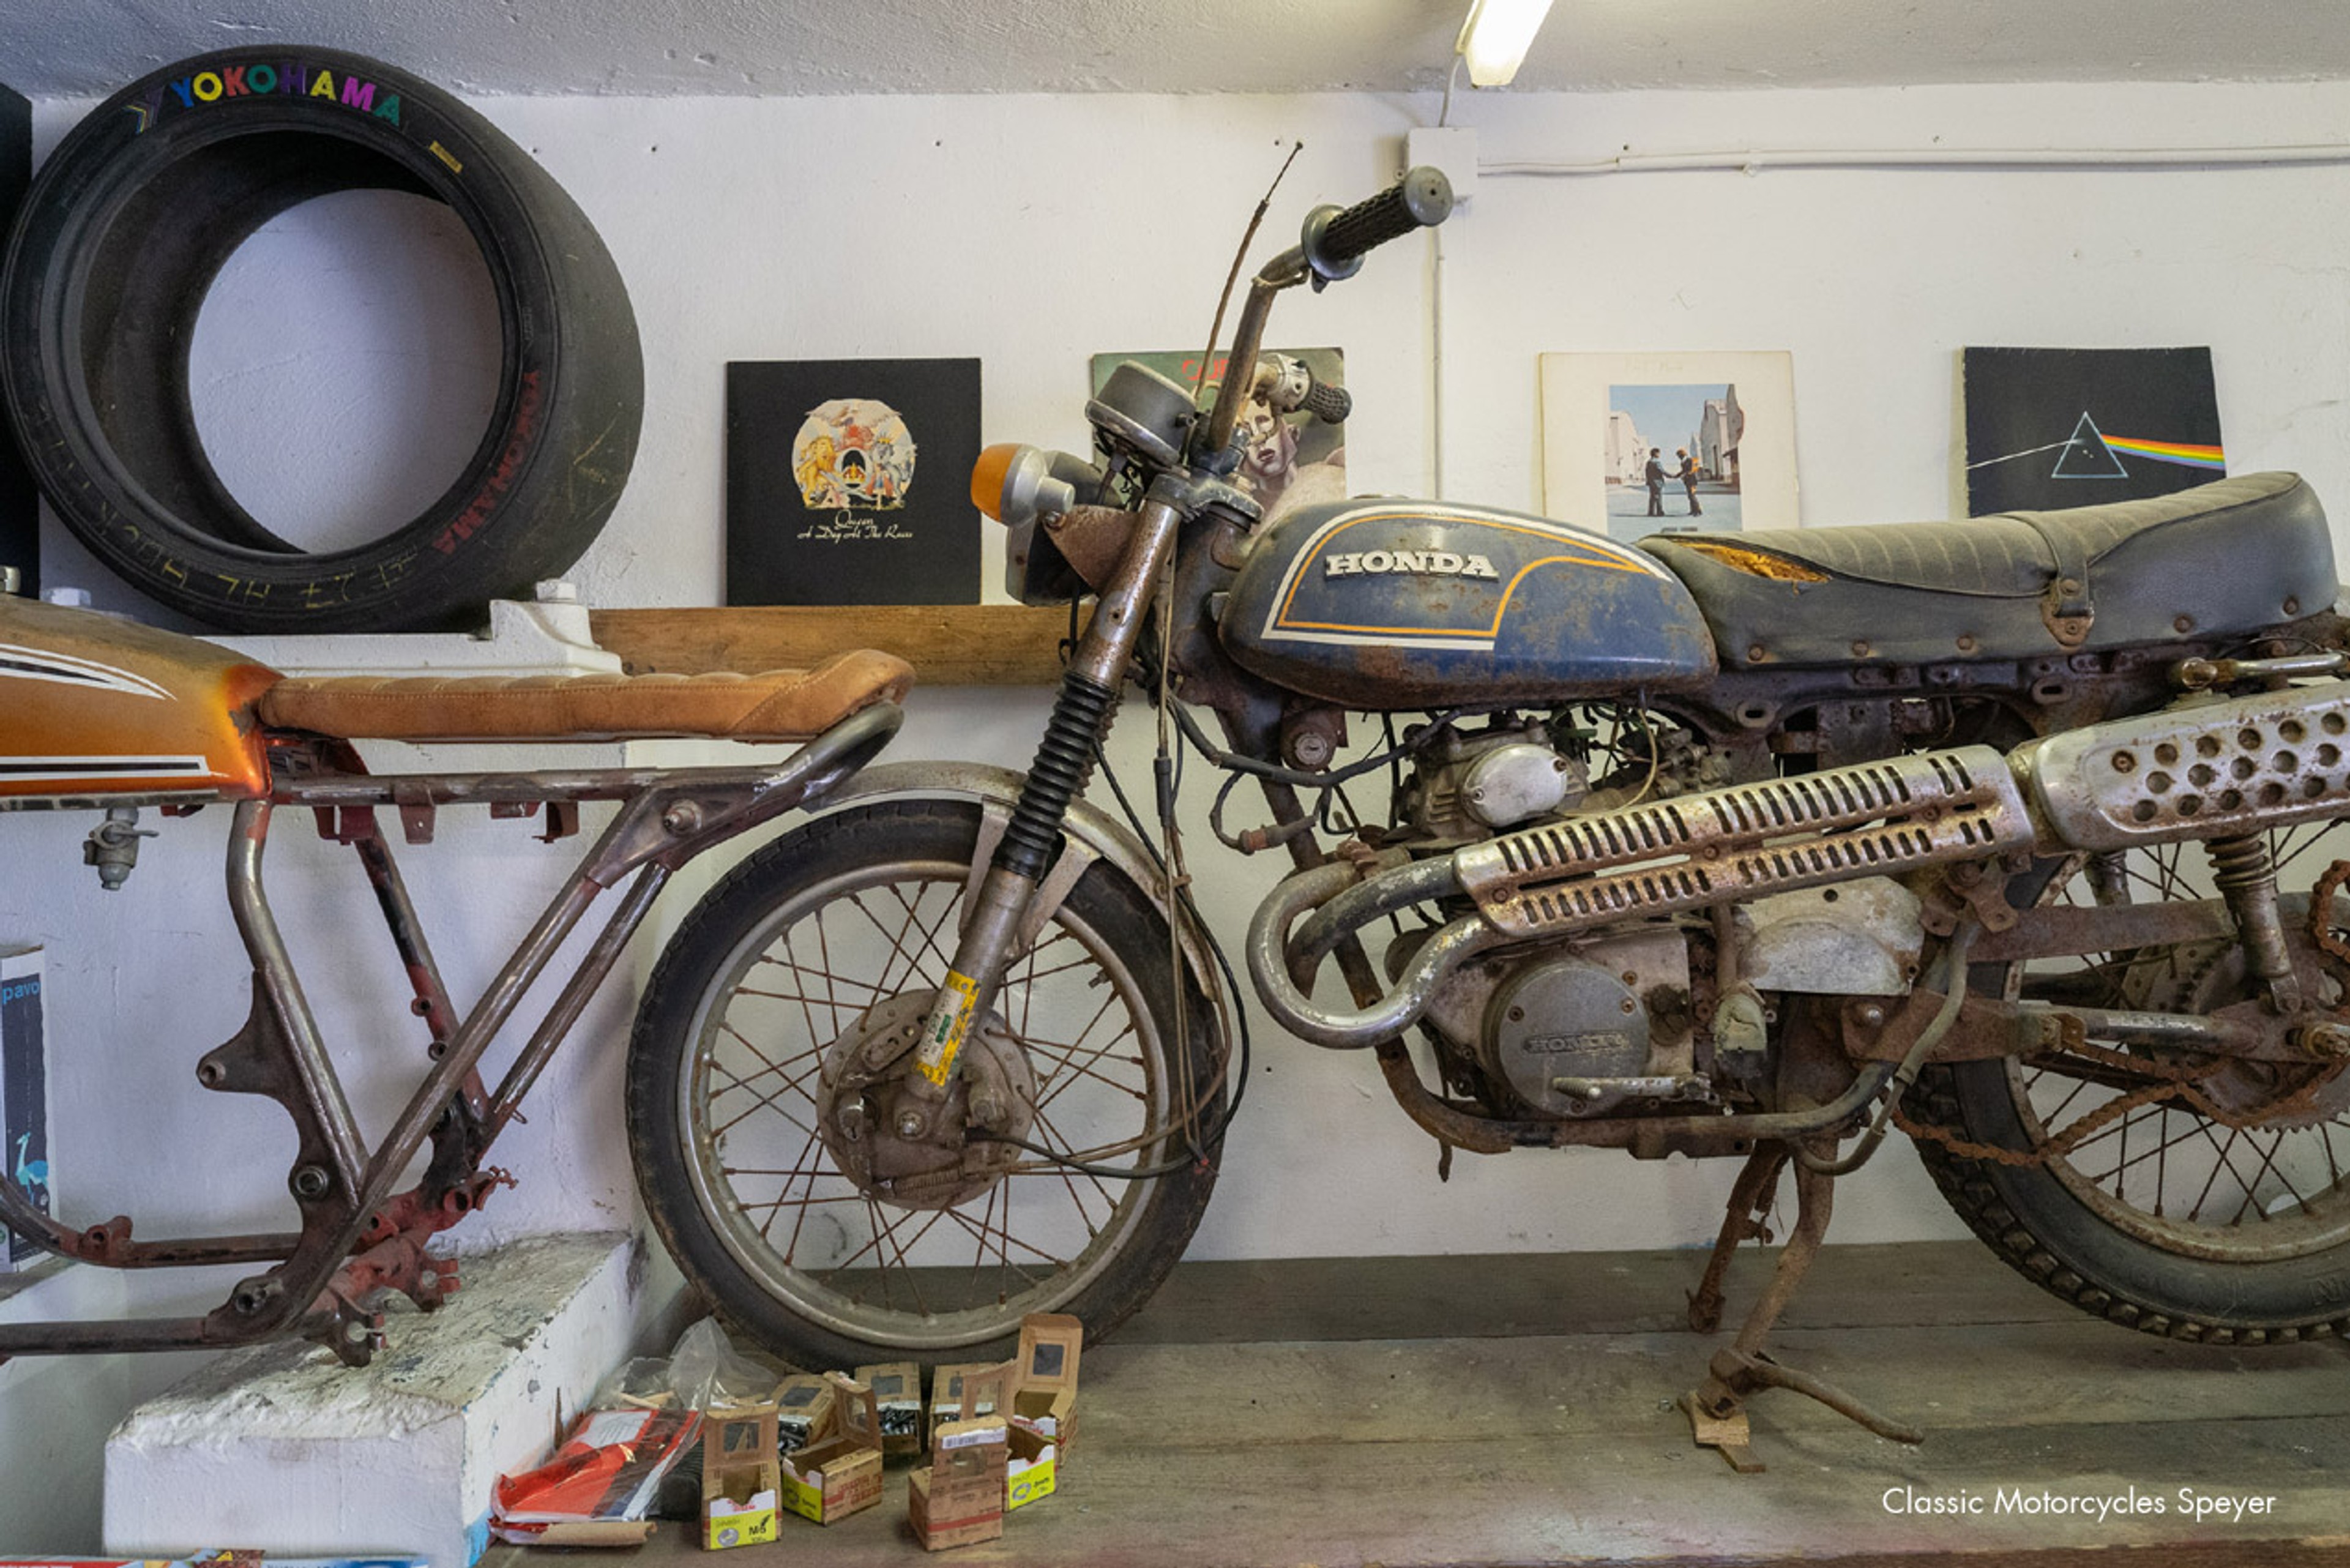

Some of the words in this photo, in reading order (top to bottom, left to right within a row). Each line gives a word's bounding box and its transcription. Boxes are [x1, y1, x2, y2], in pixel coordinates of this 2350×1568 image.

[170, 64, 401, 127] YOKOHAMA
[432, 370, 540, 554] YOKOHAMA
[1325, 550, 1499, 577] HONDA
[2, 980, 42, 1006] pavo
